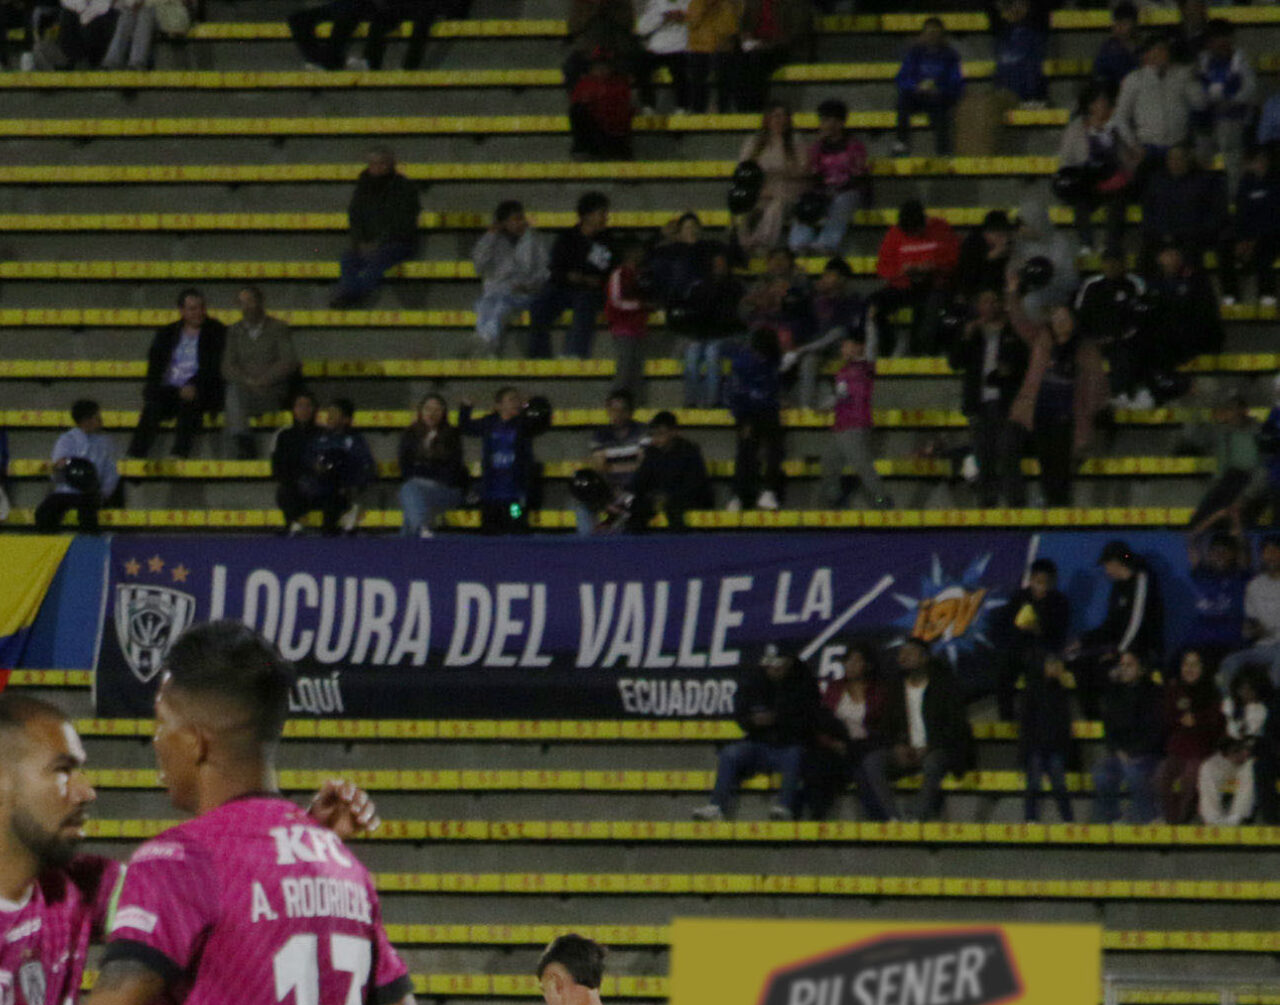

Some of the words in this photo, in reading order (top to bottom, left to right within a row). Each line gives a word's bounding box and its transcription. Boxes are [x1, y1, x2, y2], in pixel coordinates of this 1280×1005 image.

[210, 565, 431, 666] LOCURA
[444, 582, 553, 668] DEL
[575, 576, 754, 668] VALLE
[772, 568, 833, 625] LA
[288, 671, 344, 714] LQUÍ
[618, 678, 738, 717] ECUADOR
[270, 825, 352, 868] KFC
[251, 881, 278, 923] A.
